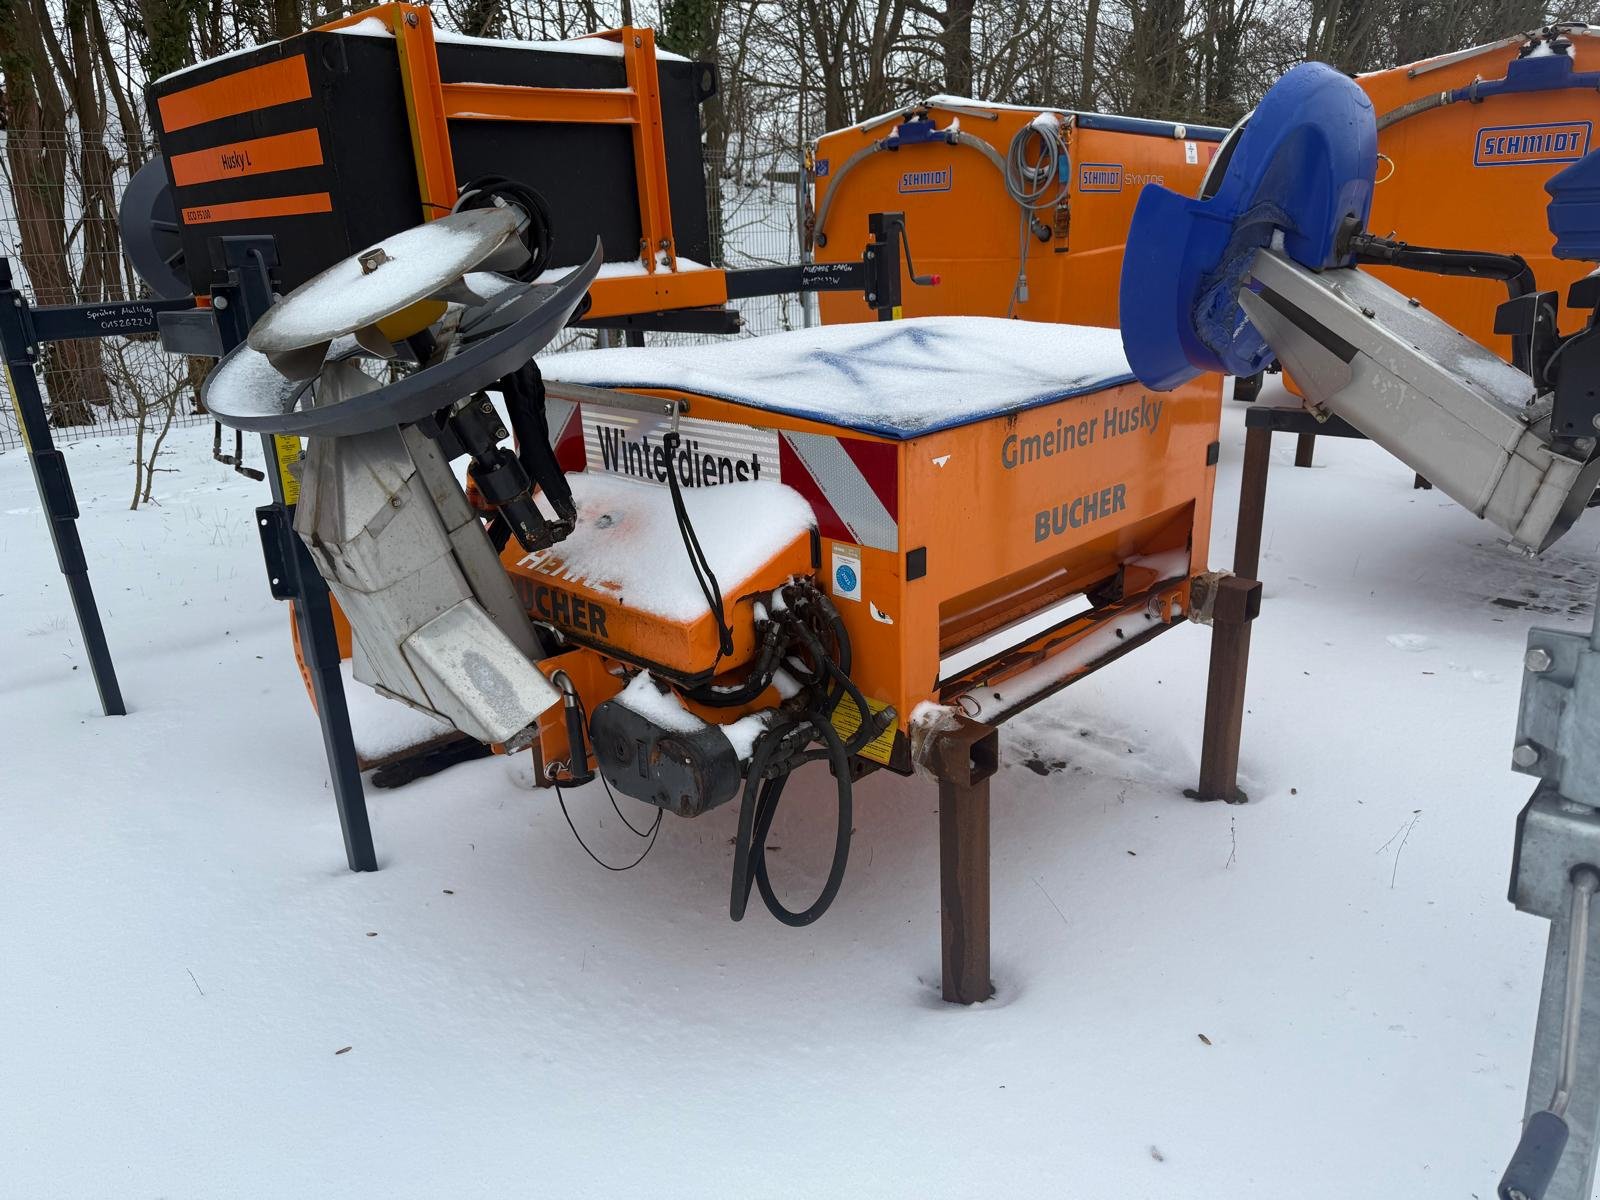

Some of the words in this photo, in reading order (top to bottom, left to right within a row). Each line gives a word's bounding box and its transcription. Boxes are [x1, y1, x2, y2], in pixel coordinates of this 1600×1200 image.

[1484, 132, 1581, 155] SCHMIDT
[221, 151, 245, 172] Husky
[246, 150, 252, 166] L
[903, 171, 946, 186] SCHMIDT
[1083, 171, 1119, 185] SCHMIDT
[1124, 173, 1164, 186] SYNTOS
[1002, 417, 1098, 470] Gmeiner
[1103, 395, 1163, 440] Husky
[1035, 483, 1127, 544] BUCHER
[513, 574, 609, 638] UCHER
